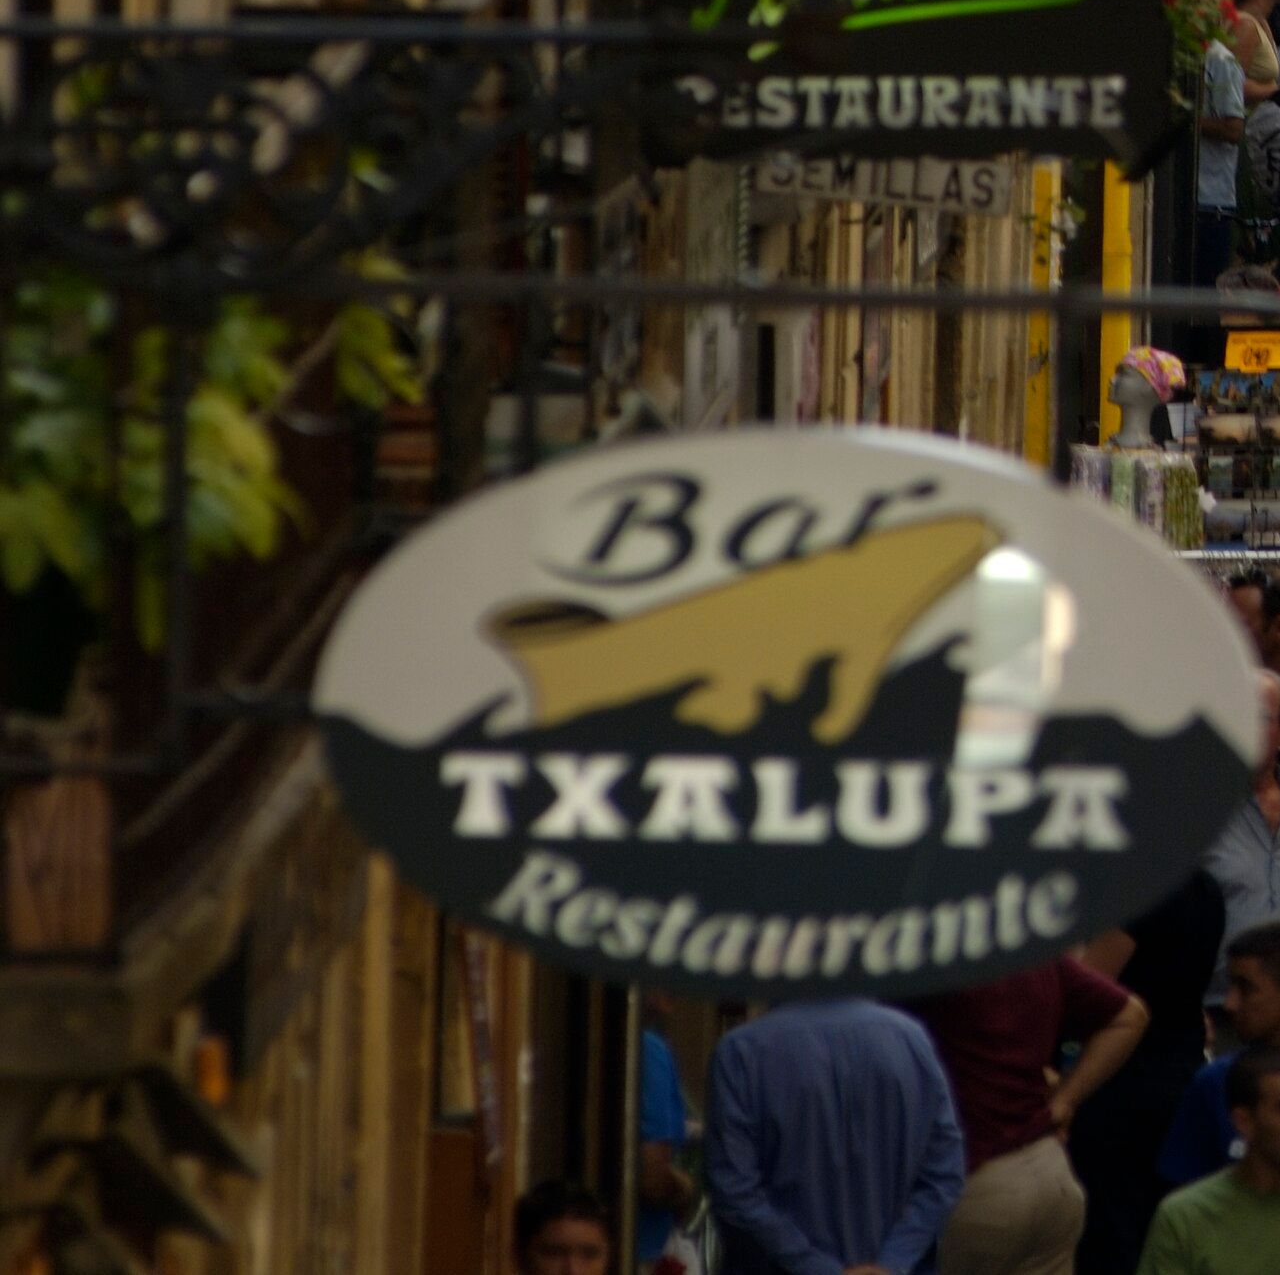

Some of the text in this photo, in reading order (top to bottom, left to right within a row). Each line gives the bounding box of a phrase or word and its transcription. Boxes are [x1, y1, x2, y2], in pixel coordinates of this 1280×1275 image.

[541, 471, 942, 587] Bar
[440, 751, 1133, 851] TXALUPA
[489, 849, 1080, 979] Restaurante
